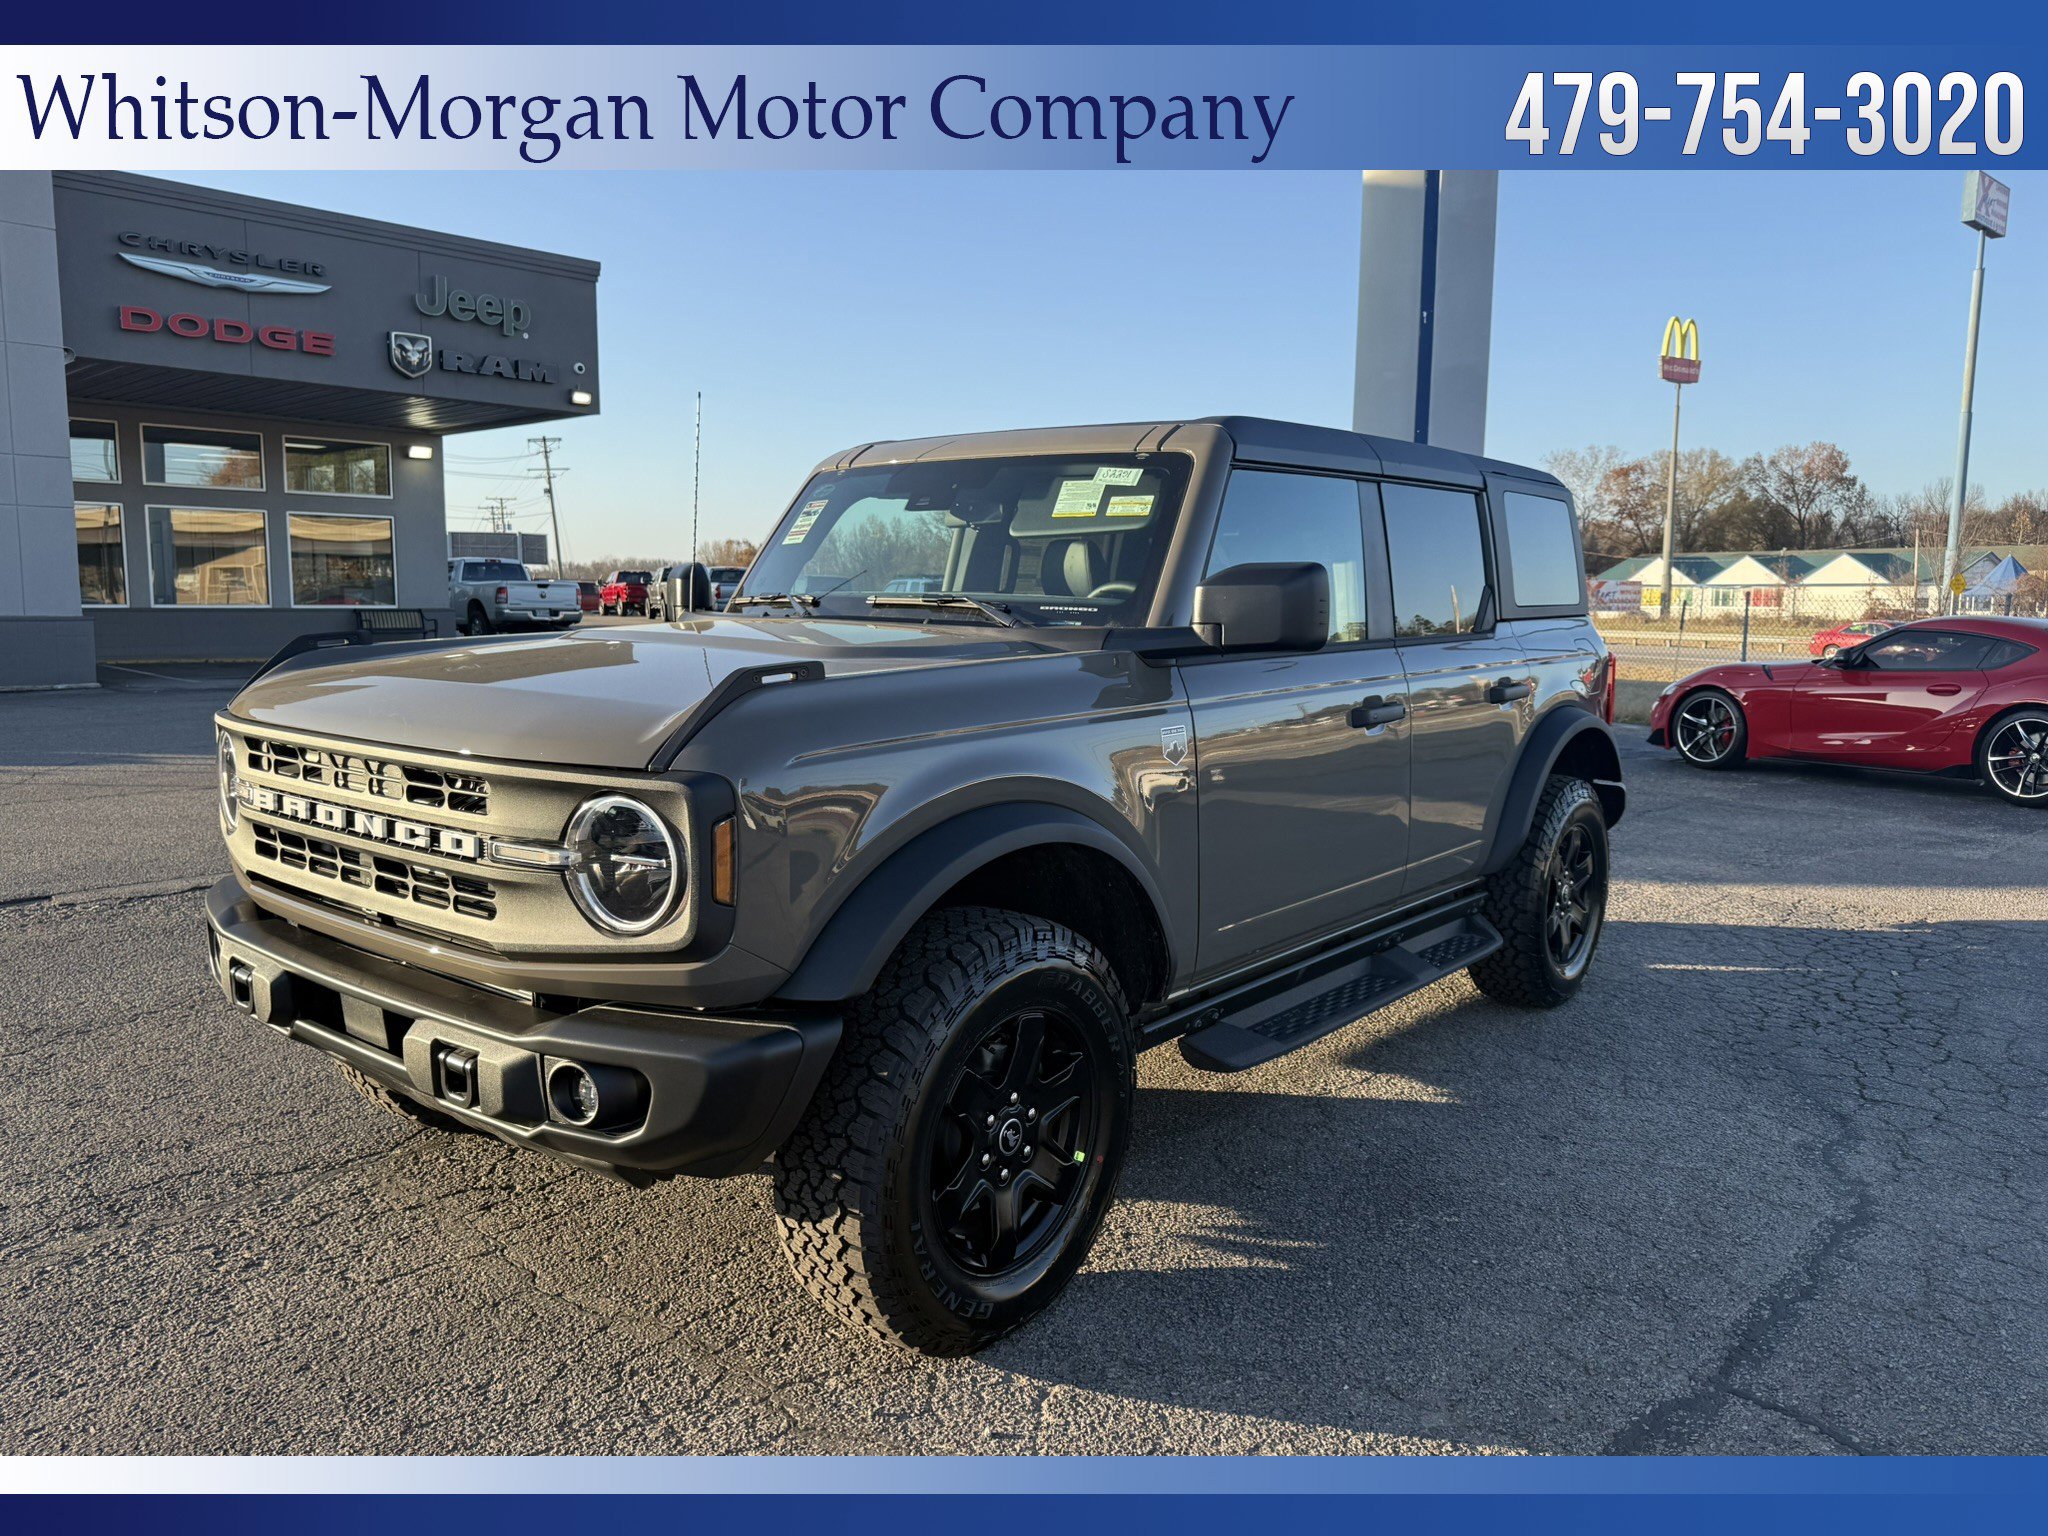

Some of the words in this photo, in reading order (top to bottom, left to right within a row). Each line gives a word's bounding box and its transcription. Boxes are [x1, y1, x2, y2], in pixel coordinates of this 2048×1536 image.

[118, 230, 327, 278] CHRYSLER
[119, 304, 337, 356] DODGE
[414, 273, 532, 337] Jeep
[440, 349, 560, 384] RAM
[251, 786, 481, 859] BRONCO
[909, 1216, 996, 1320] GENERAL
